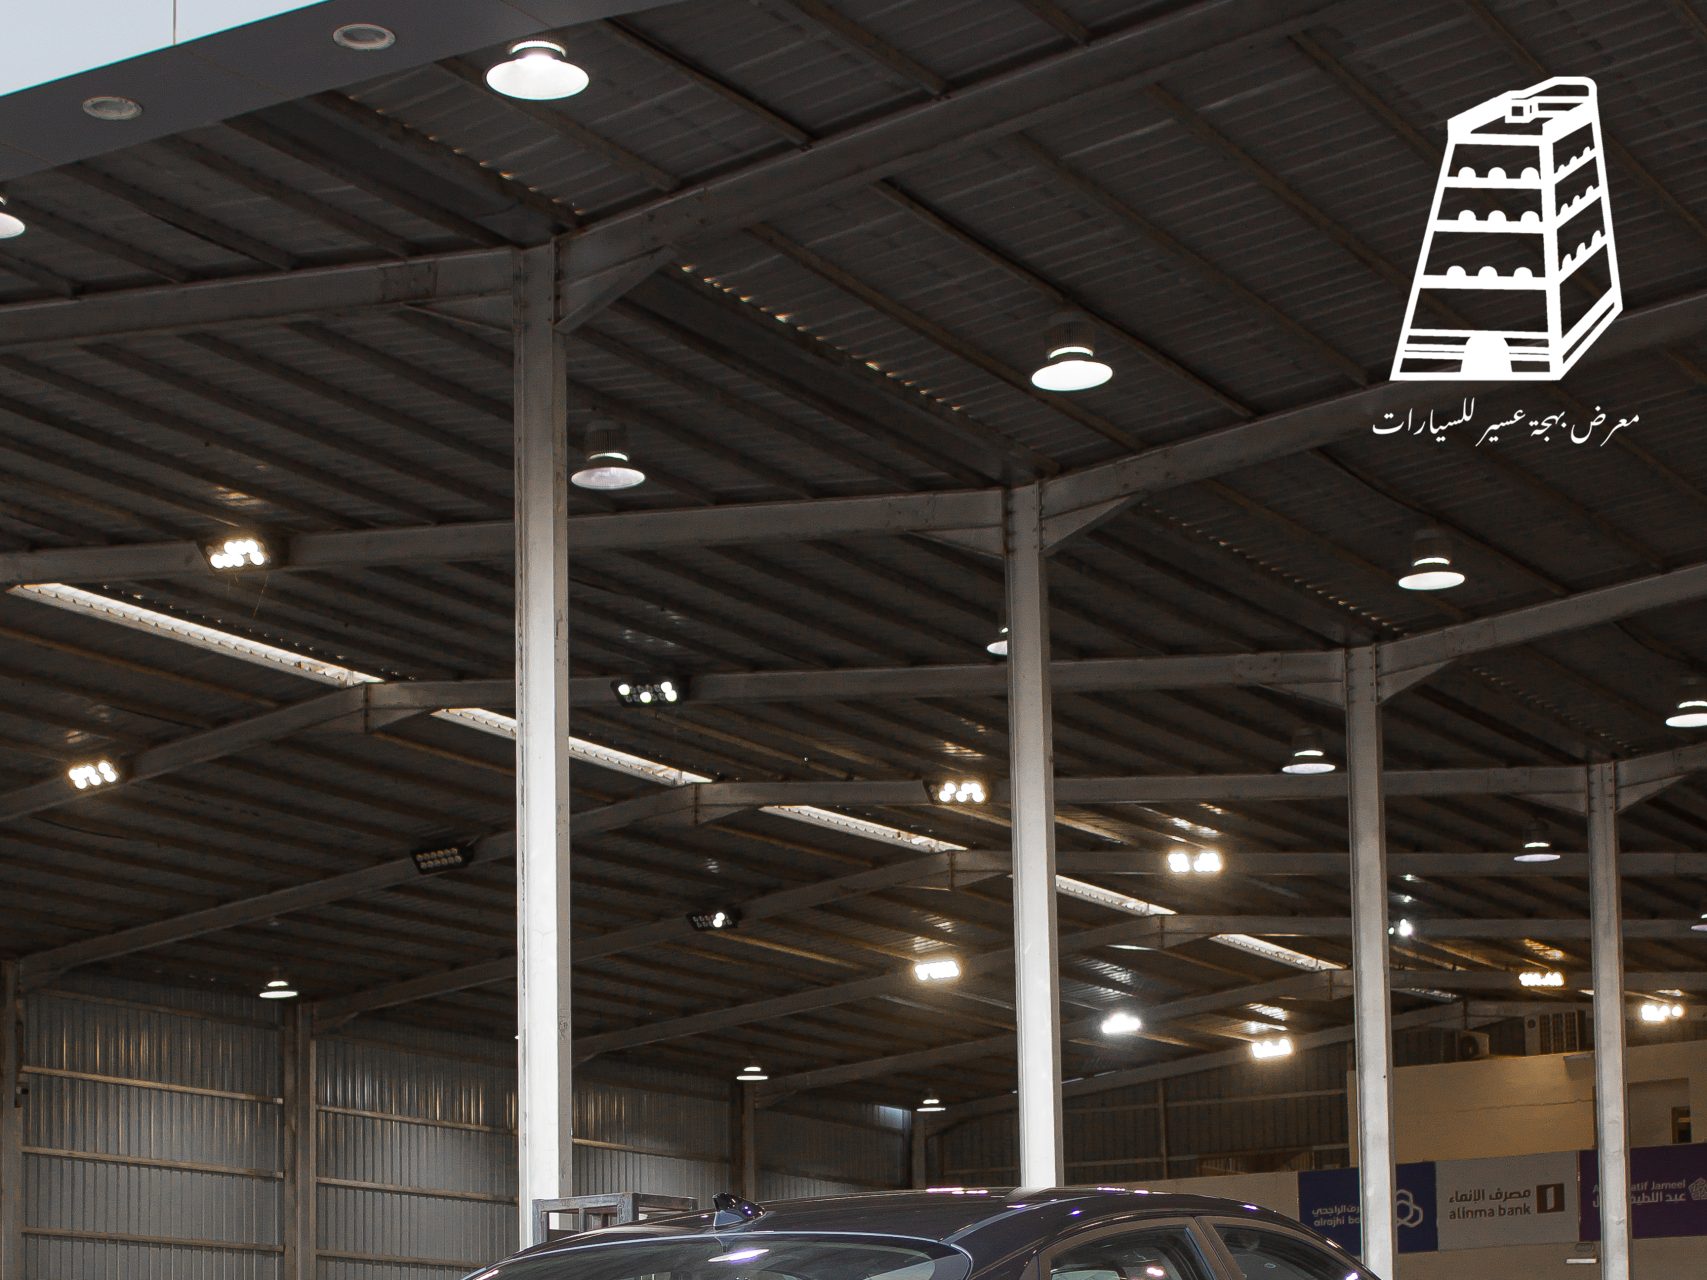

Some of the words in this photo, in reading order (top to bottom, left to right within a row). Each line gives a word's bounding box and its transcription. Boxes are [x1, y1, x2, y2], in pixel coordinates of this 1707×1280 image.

[1631, 1181, 1650, 1192] atif
[1651, 1179, 1686, 1191] Jameel
[1489, 1187, 1531, 1202] مصرف
[1449, 1207, 1495, 1220] alinma
[1498, 1203, 1531, 1217] bank
[1313, 1216, 1345, 1228] alrajhi
